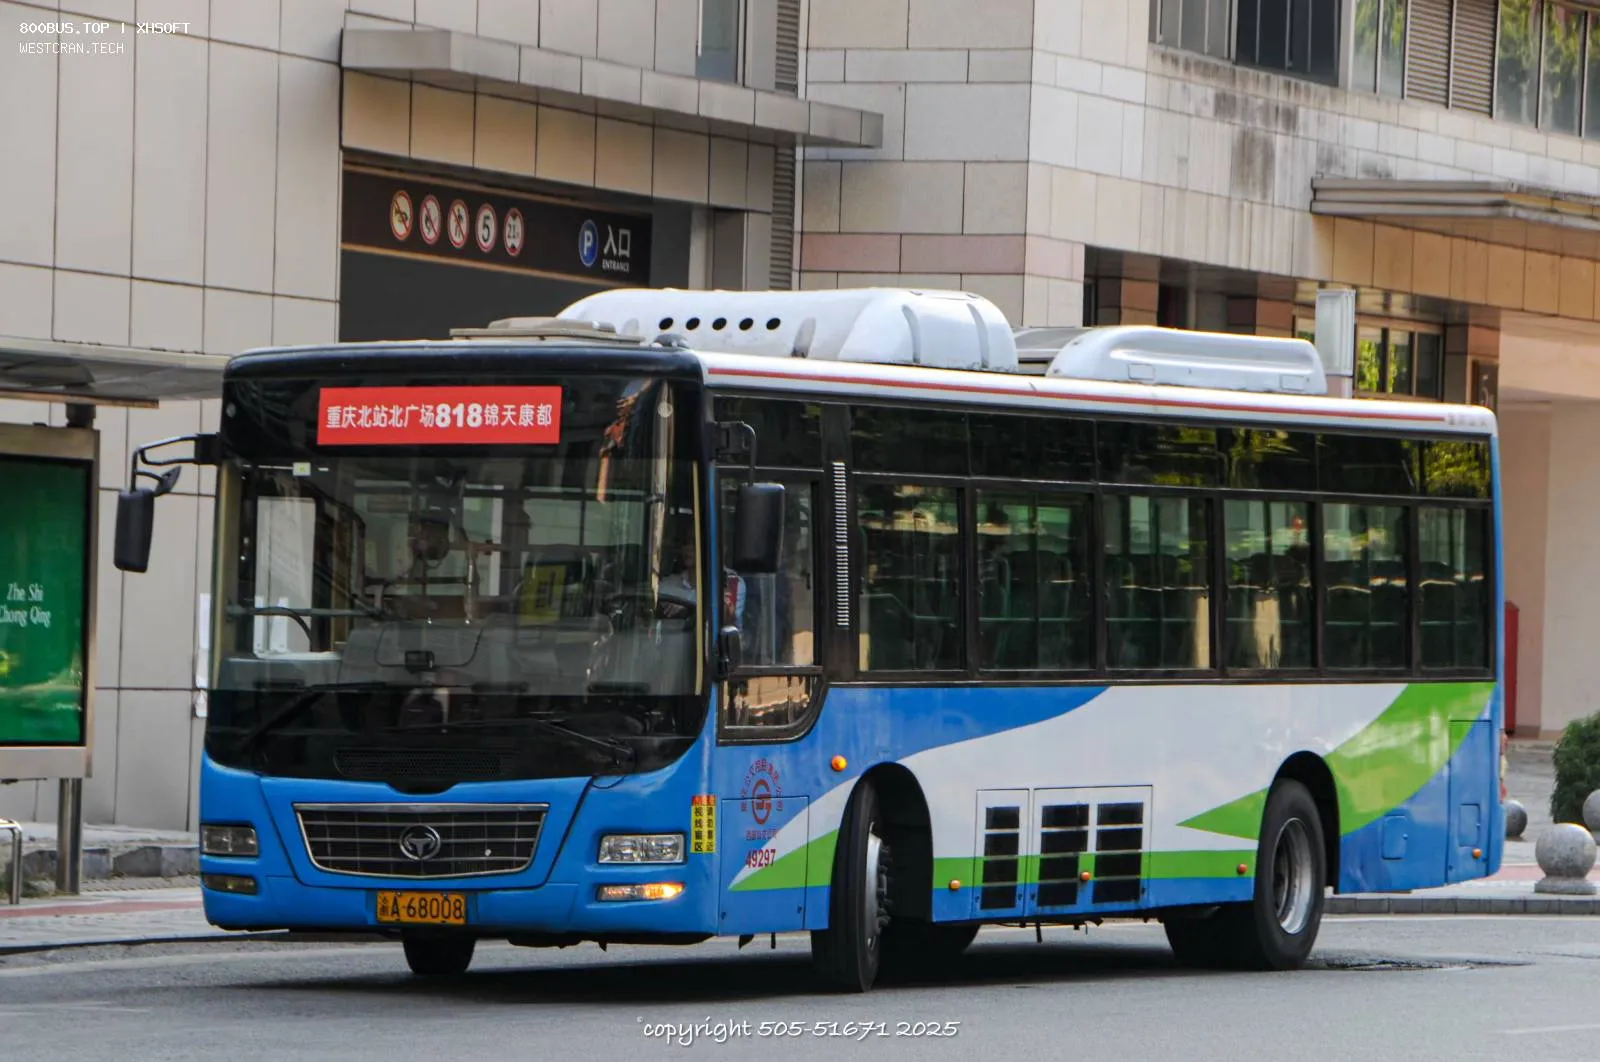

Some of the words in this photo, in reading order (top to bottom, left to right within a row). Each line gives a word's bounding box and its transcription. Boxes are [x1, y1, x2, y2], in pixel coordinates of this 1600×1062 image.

[481, 214, 491, 243] 5
[583, 230, 593, 256] P
[603, 224, 631, 258] 入口
[602, 259, 630, 272] ENTRANCE
[28, 582, 44, 601] Shi
[30, 606, 52, 629] Qing
[746, 849, 776, 868] 49297
